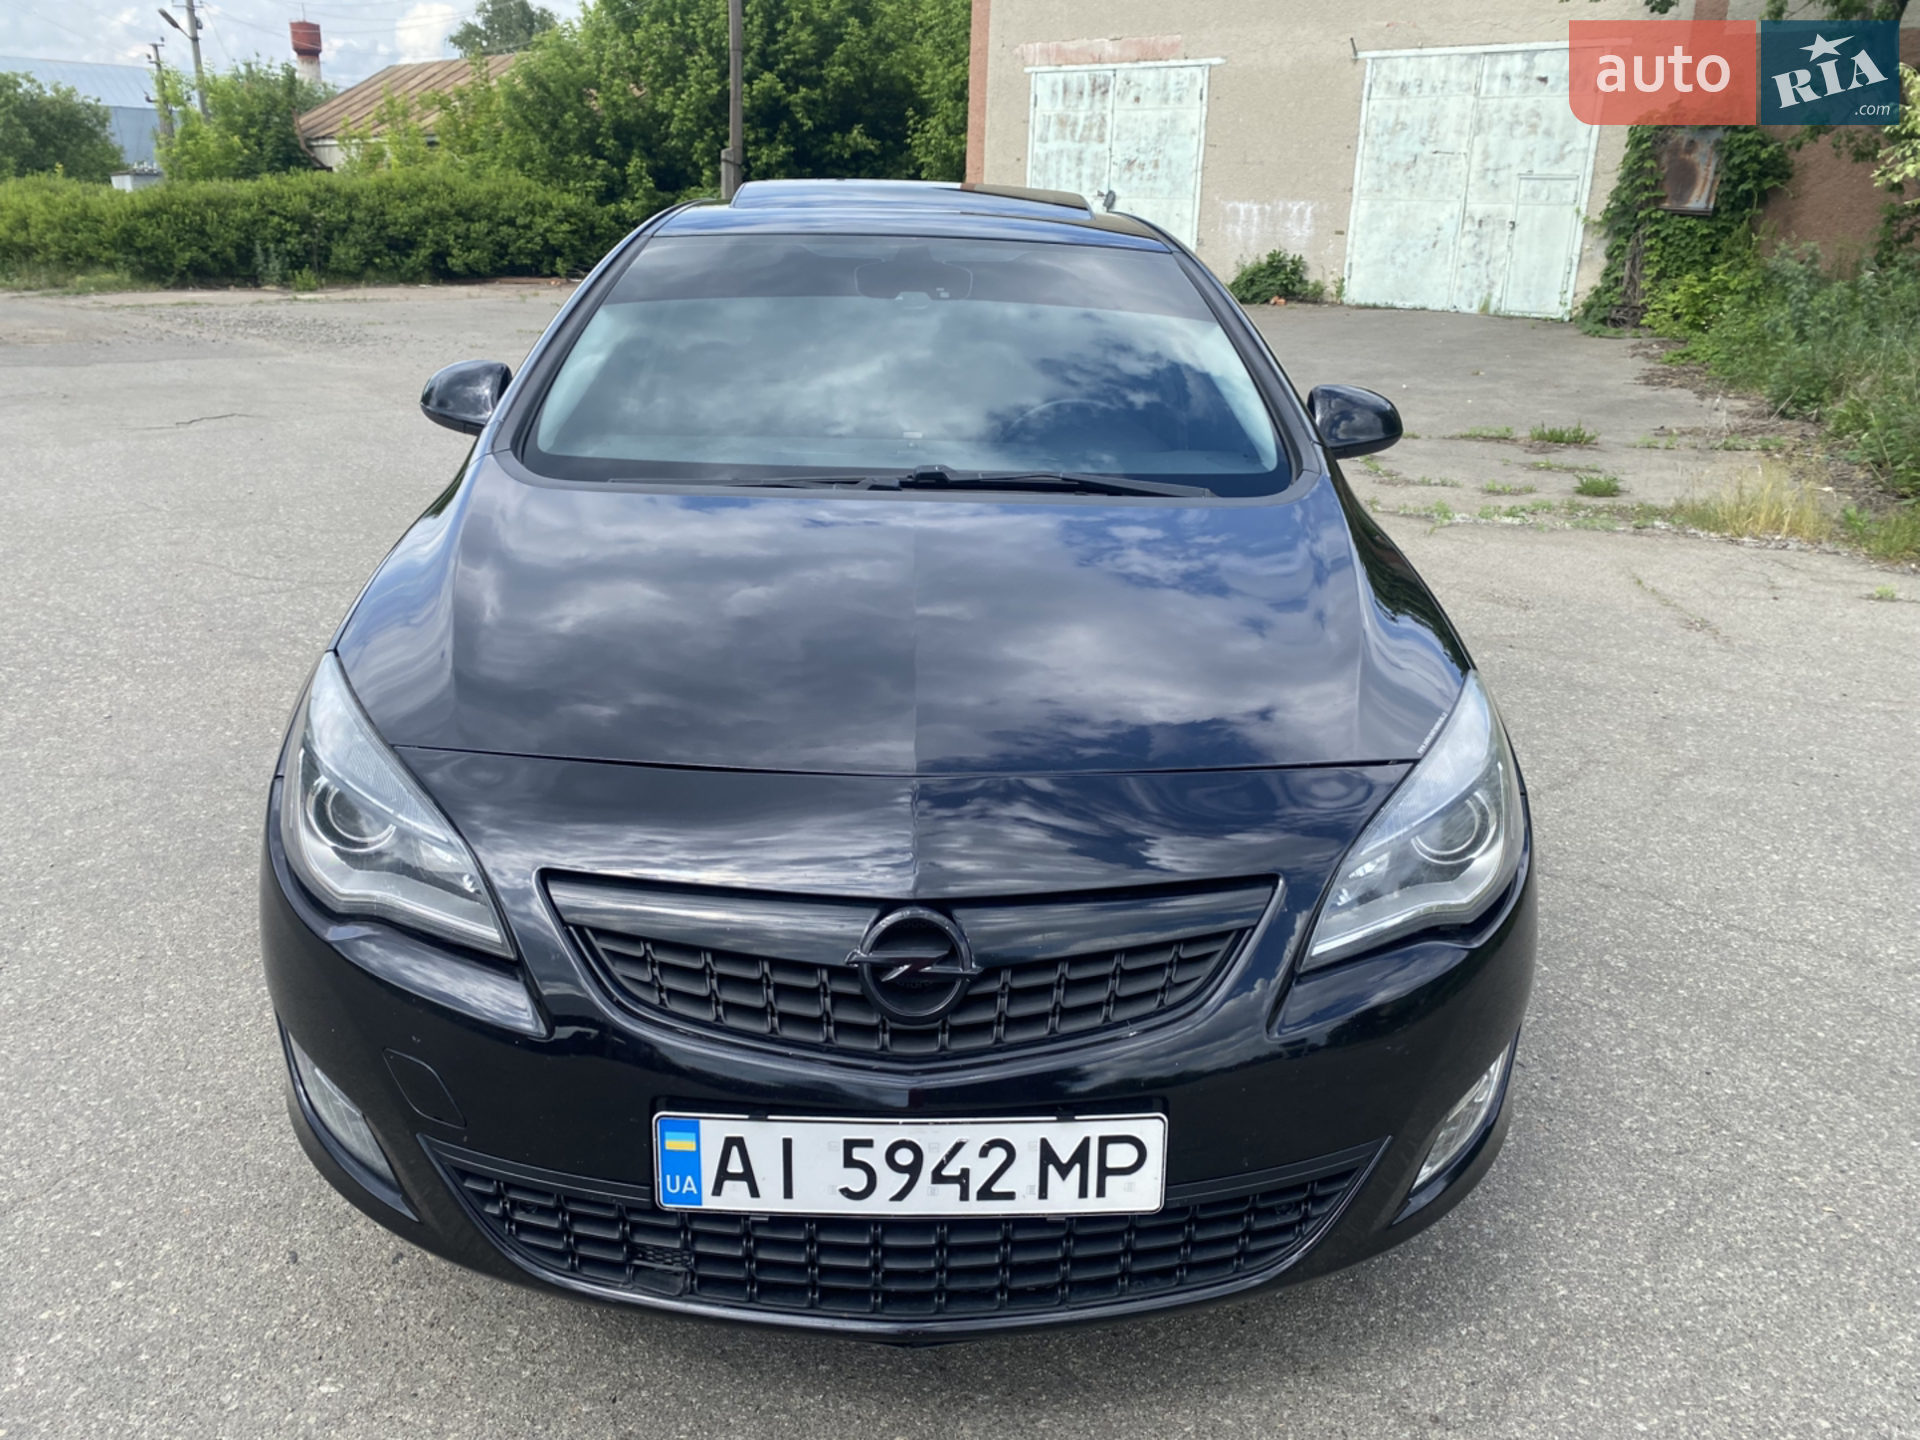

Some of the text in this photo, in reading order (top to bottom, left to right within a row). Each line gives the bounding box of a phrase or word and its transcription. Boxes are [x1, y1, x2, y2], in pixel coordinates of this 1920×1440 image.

[666, 1175, 697, 1195] UA
[711, 1134, 1148, 1202] AI 5942 MP
